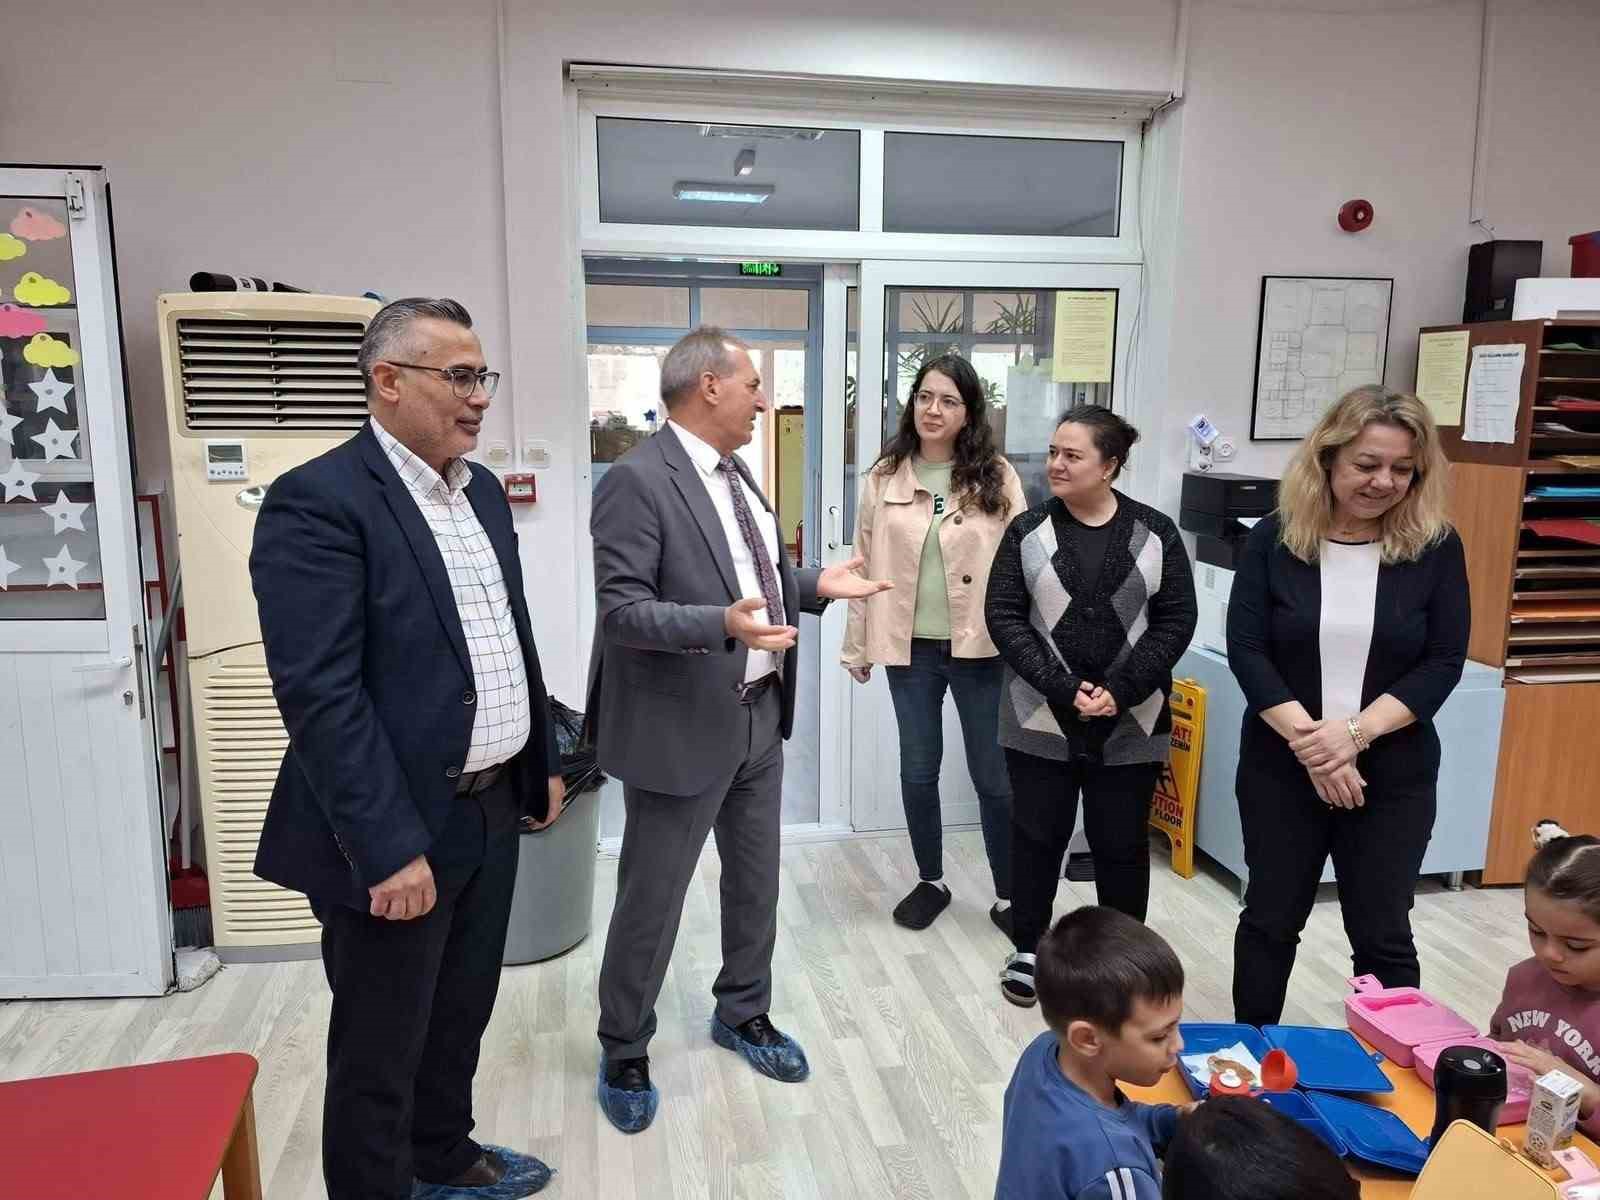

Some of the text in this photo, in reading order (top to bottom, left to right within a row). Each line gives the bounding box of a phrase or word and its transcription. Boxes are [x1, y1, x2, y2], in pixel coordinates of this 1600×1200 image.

[1172, 725, 1192, 743] AT!
[1154, 808, 1183, 828] FLOOR
[1507, 1010, 1551, 1033] NEW
